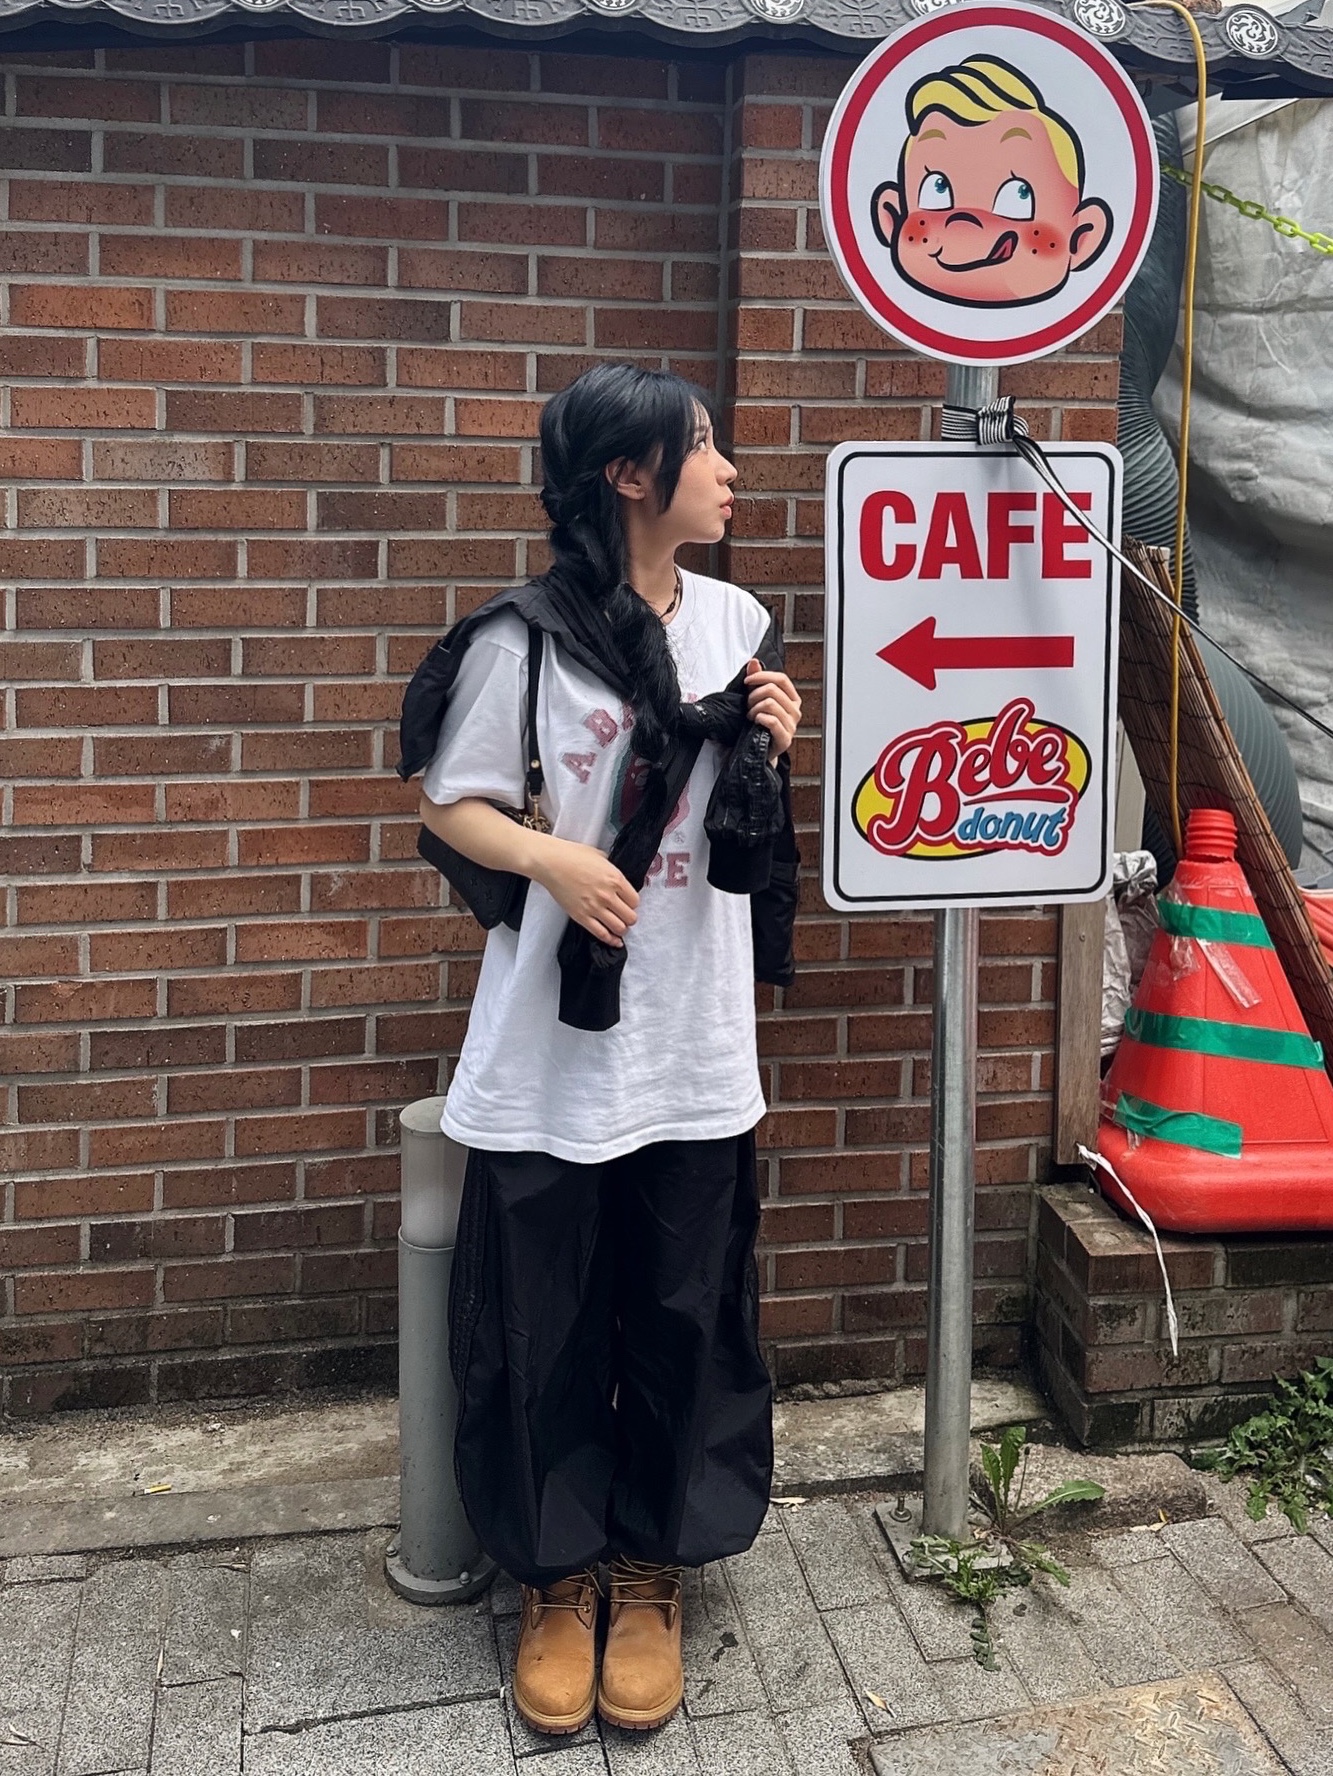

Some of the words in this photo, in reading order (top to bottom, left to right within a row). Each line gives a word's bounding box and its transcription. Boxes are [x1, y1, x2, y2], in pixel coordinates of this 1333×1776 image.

[859, 490, 1093, 581] CAFE
[872, 704, 1066, 848] Bebe
[957, 806, 1067, 847] donut
